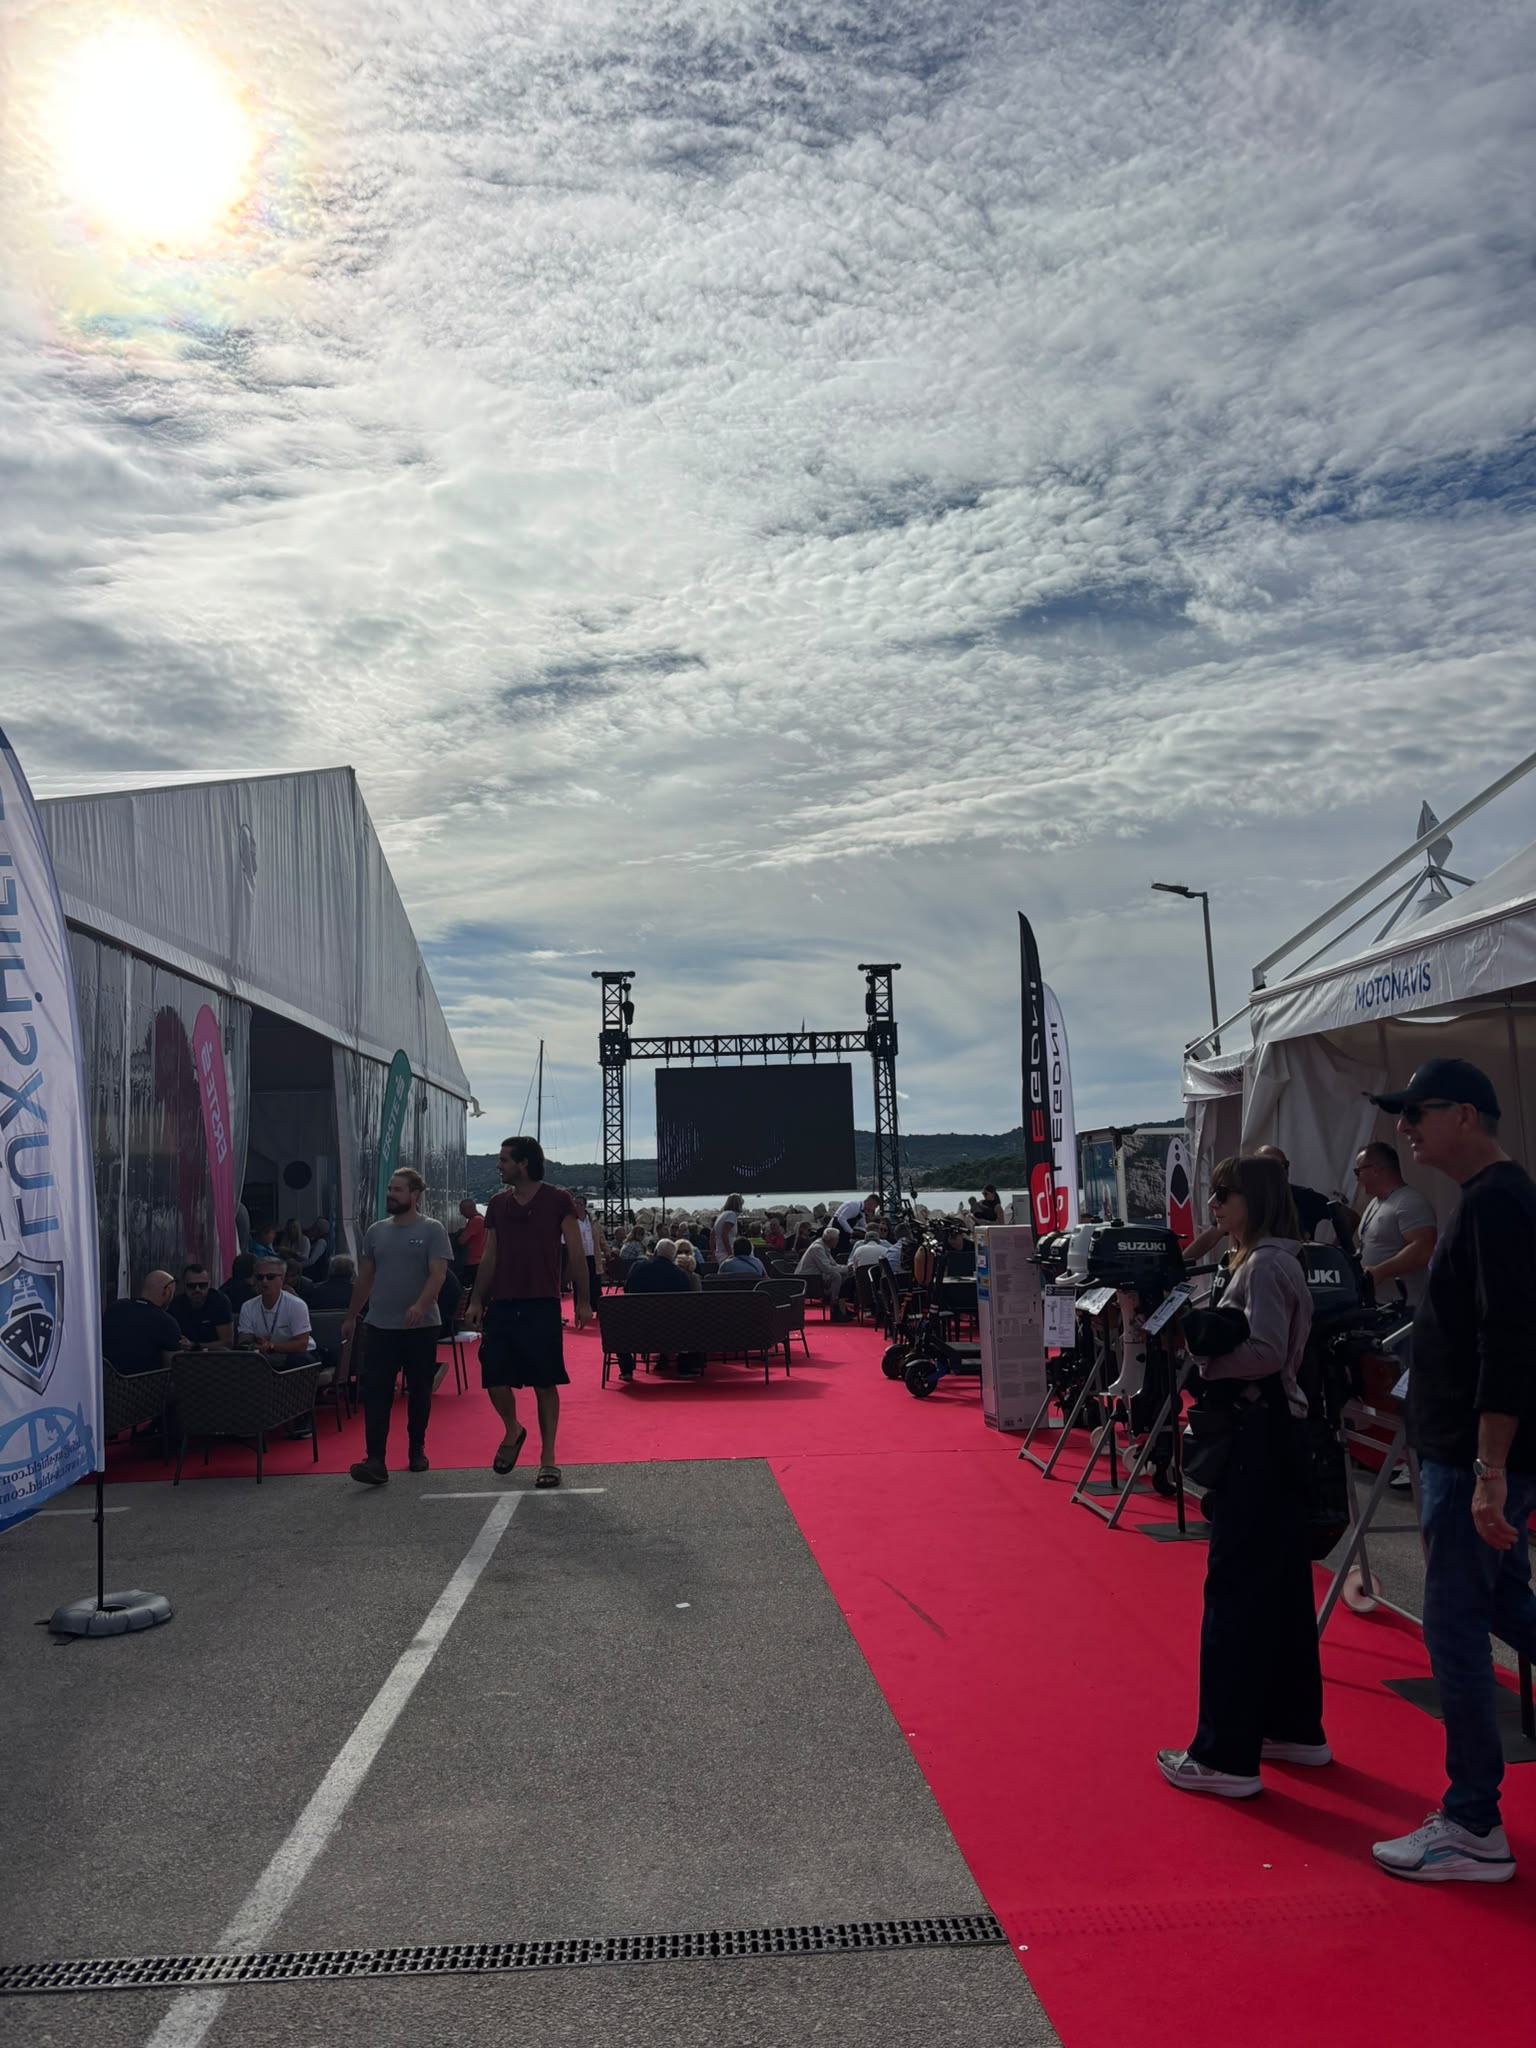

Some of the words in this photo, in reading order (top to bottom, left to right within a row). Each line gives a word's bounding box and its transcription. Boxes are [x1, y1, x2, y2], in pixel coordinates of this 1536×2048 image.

[1354, 962, 1431, 1011] MOTONAVIS
[382, 1096, 400, 1162] ERSTE
[1117, 1241, 1167, 1251] SUZUKI
[1306, 1269, 1341, 1284] UKI
